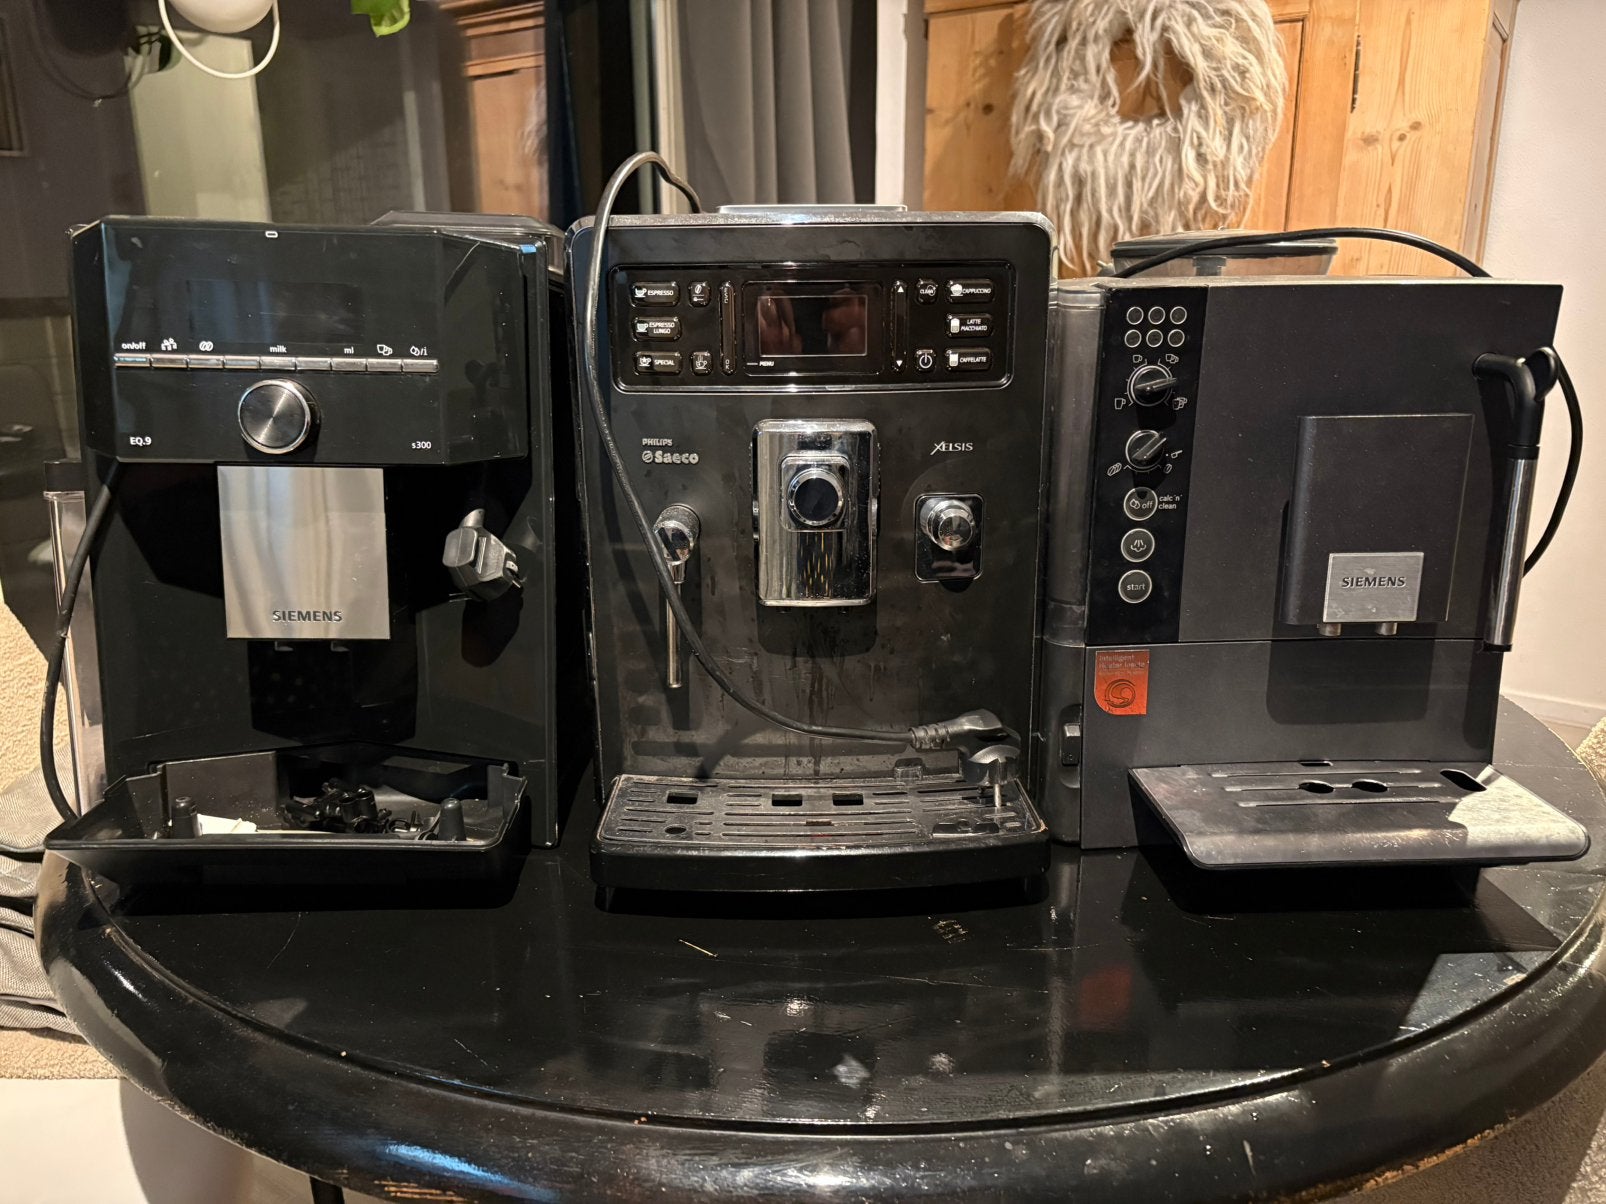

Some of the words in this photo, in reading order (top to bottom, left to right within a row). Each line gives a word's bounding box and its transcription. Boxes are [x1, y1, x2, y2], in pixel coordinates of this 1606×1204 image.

[121, 342, 147, 350] on/off
[269, 344, 287, 353] milk
[344, 346, 355, 355] ml
[129, 436, 152, 447] EQ.9
[411, 440, 432, 449] s300
[642, 438, 673, 446] PHILIPS
[930, 441, 973, 456] XELSIS
[654, 450, 699, 464] Saeco
[1141, 500, 1153, 510] off
[1126, 583, 1146, 591] start
[1341, 576, 1407, 589] SIEMENS
[272, 610, 343, 623] SIEMENS
